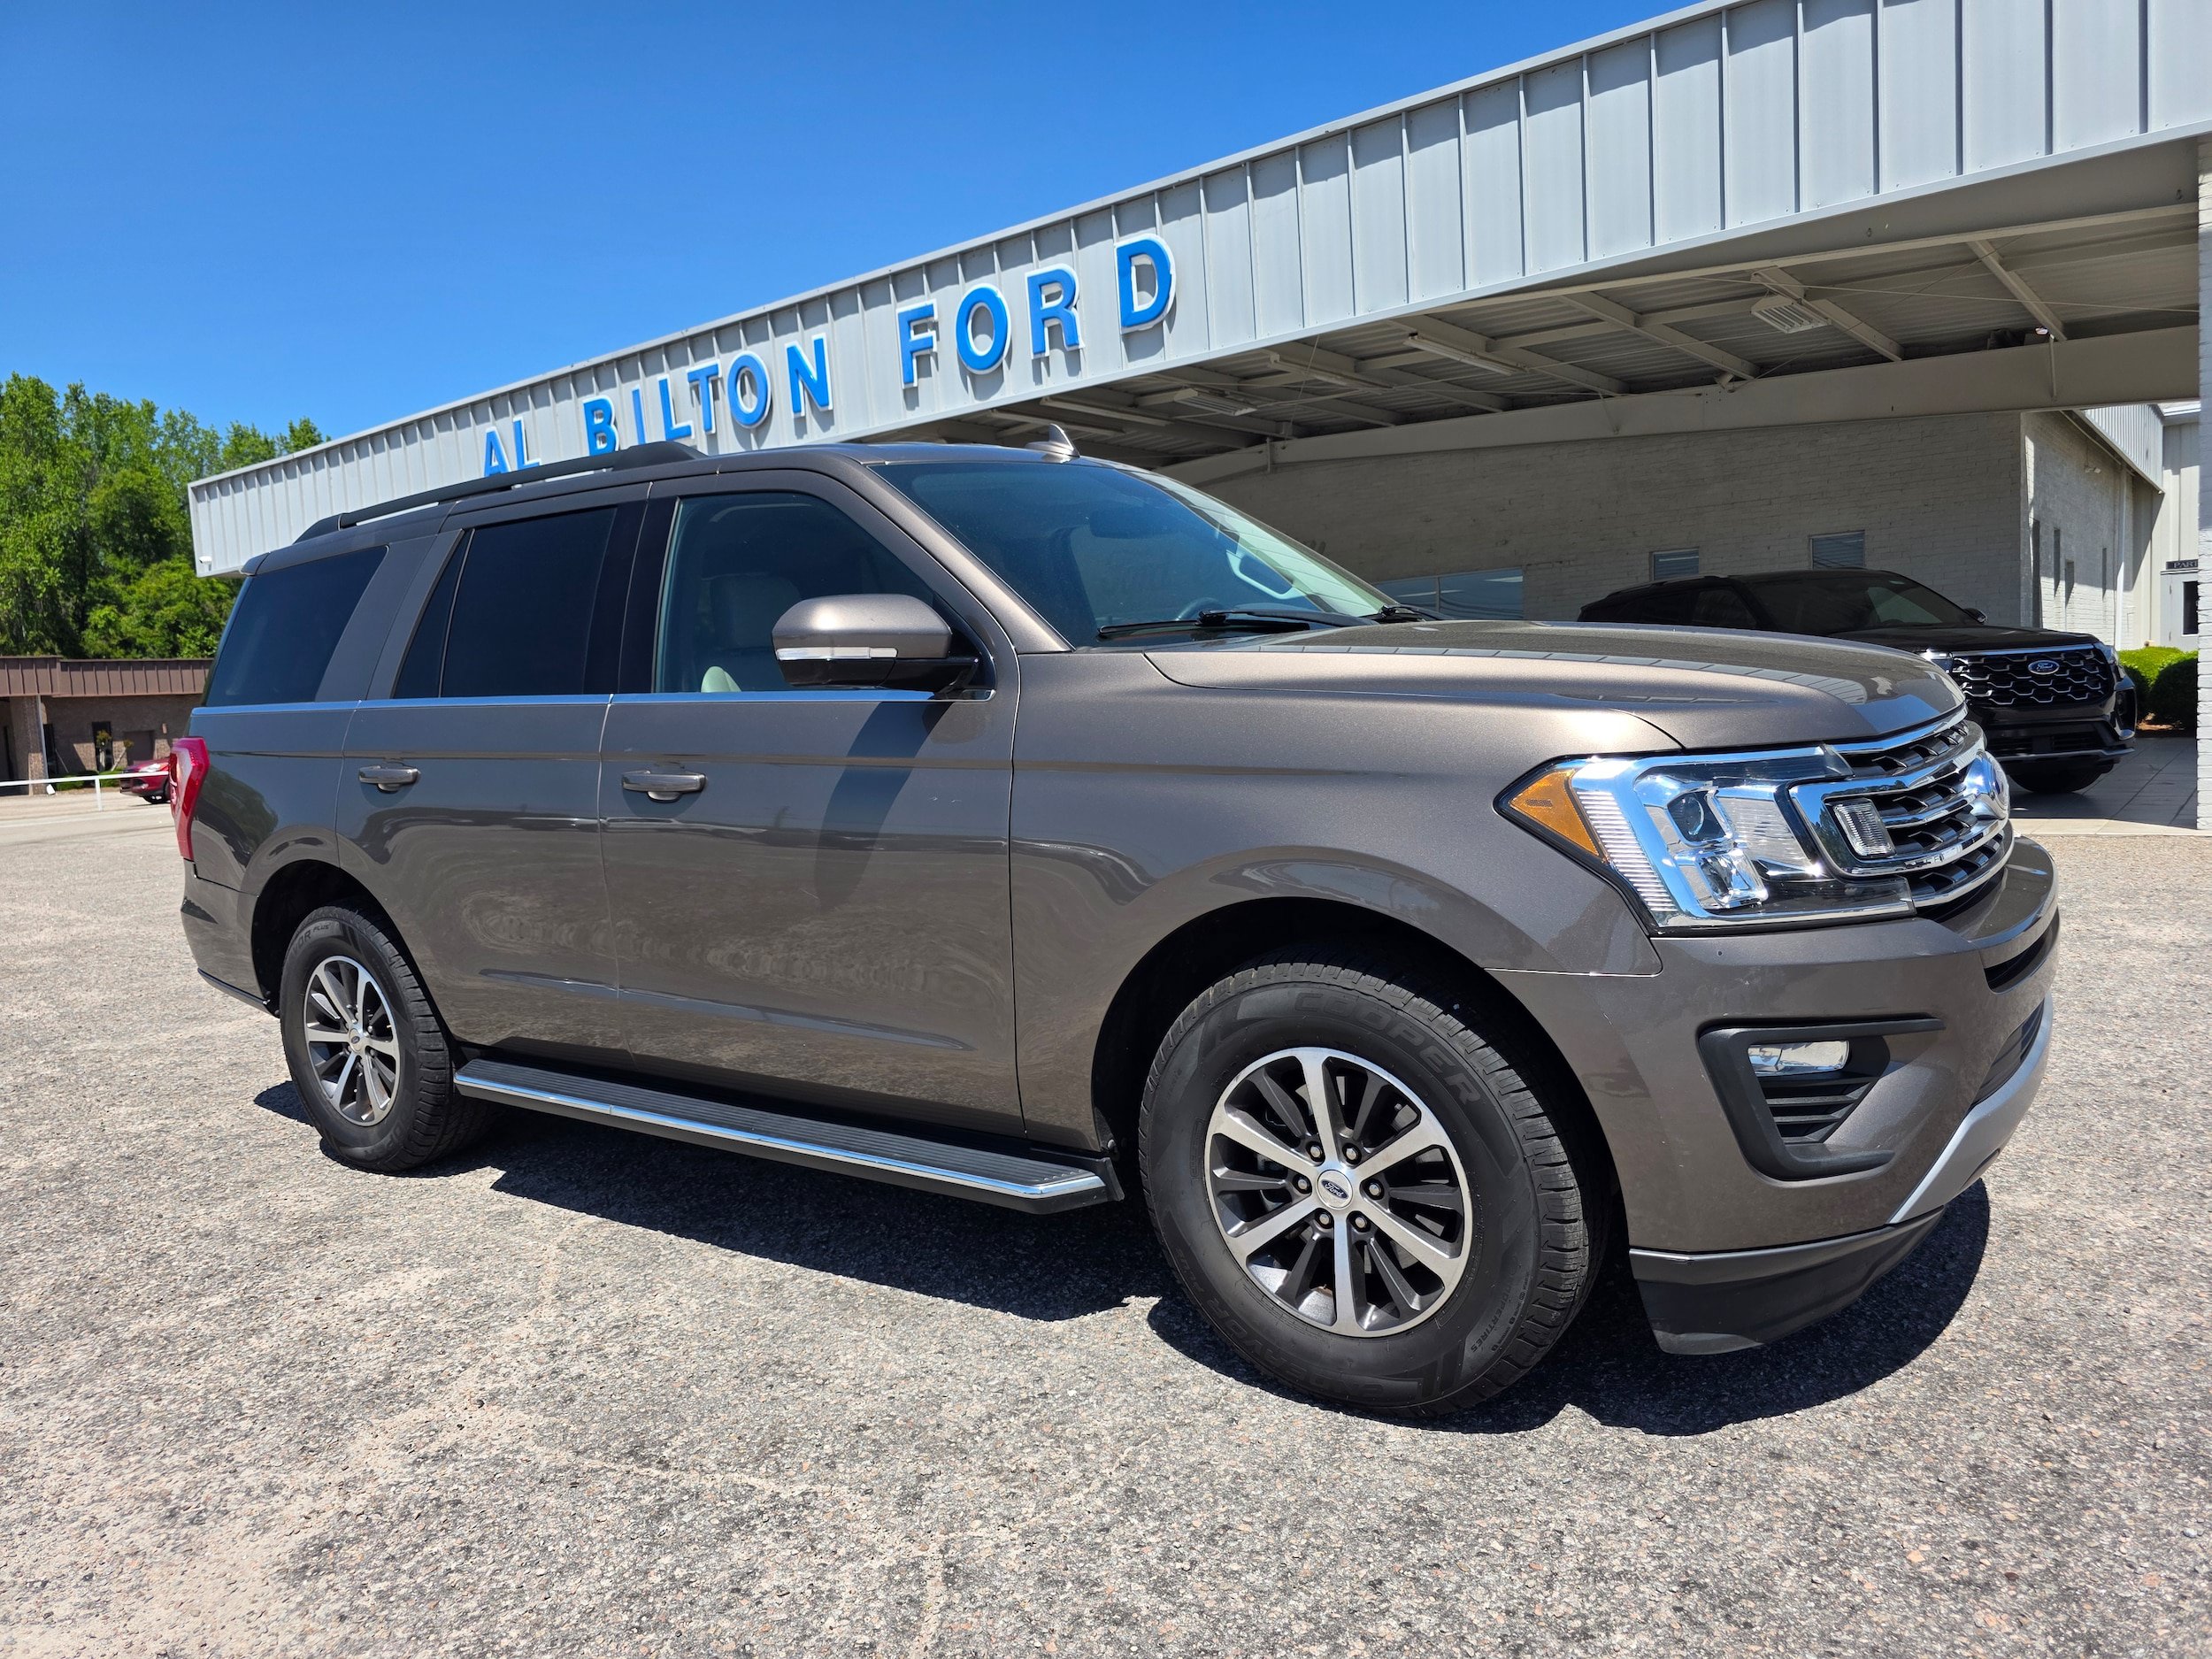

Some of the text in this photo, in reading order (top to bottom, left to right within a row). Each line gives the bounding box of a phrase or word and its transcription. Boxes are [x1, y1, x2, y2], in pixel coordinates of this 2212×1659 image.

[484, 233, 1176, 477] AL BILTON FORD
[1294, 992, 1481, 1106] COOPER
